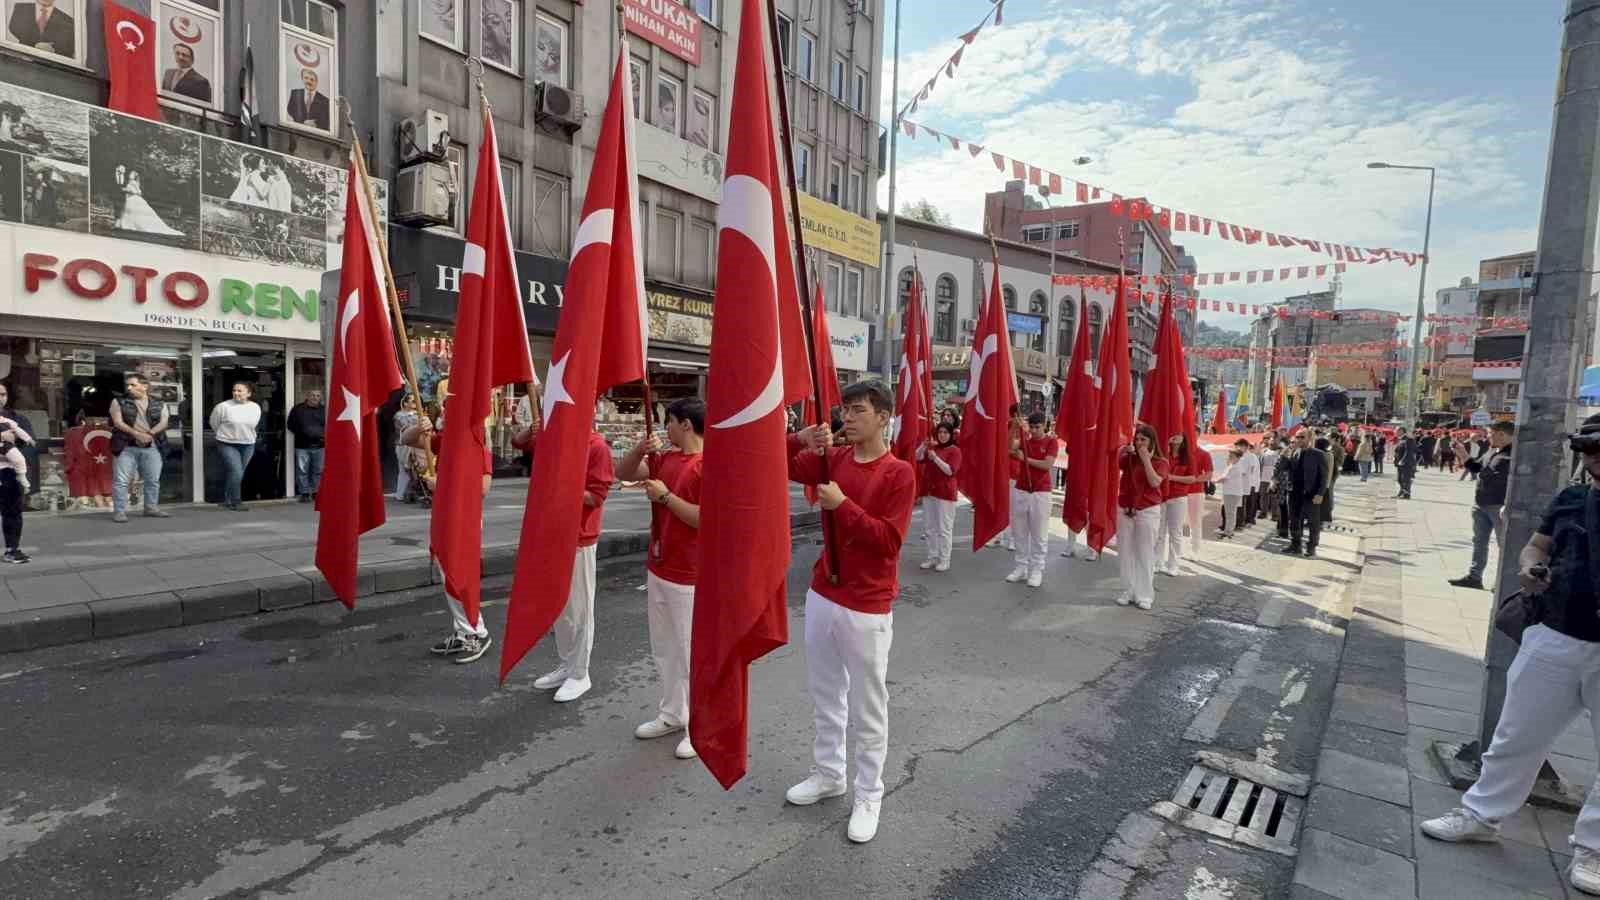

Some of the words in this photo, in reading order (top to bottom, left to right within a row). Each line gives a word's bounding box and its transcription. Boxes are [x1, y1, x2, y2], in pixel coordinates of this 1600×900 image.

[668, 29, 696, 53] AKIN
[23, 252, 209, 309] FOTO
[220, 278, 320, 321] REN
[436, 264, 563, 307] HRY
[144, 313, 207, 327] 1968'DEN
